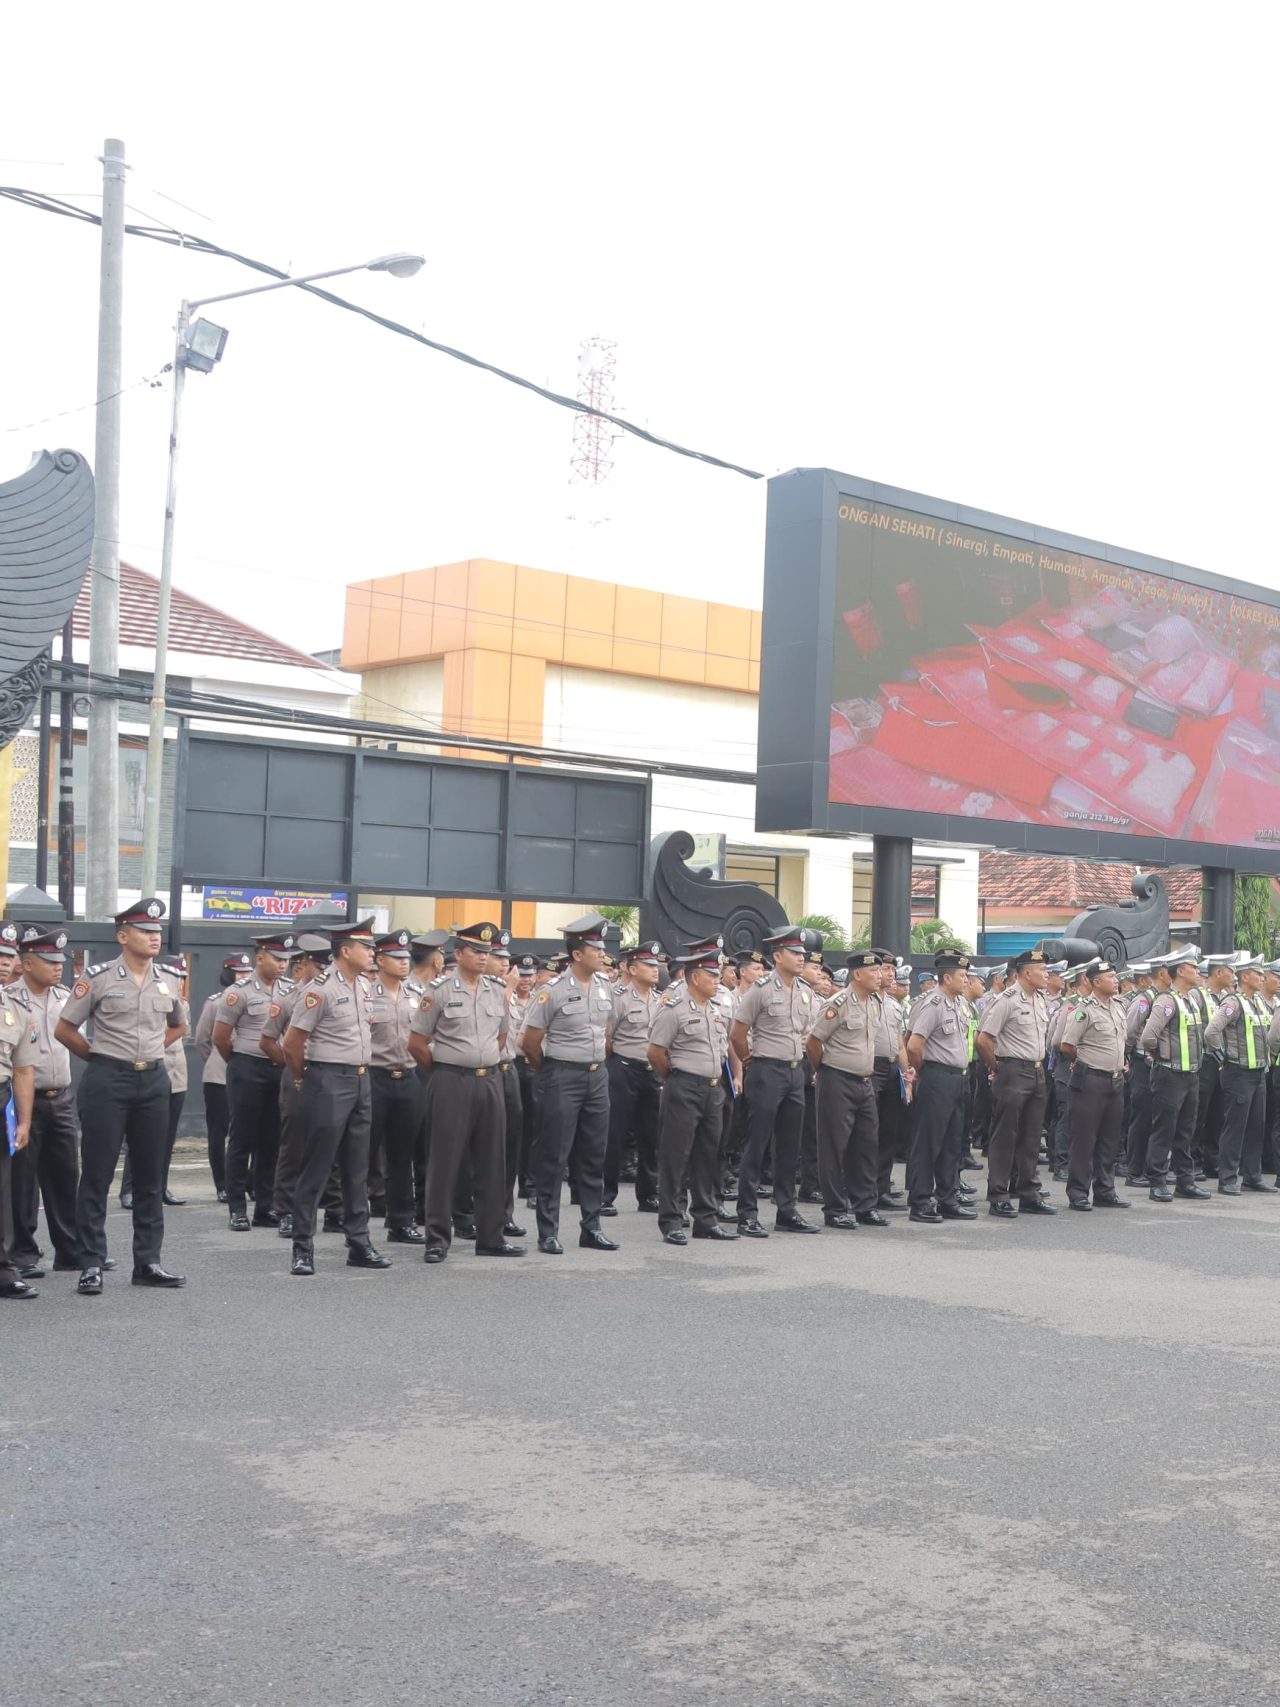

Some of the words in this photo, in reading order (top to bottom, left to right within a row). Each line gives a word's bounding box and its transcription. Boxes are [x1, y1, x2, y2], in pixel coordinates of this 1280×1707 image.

[838, 505, 889, 529] ONGAN
[891, 518, 936, 542] SEHATI
[945, 531, 988, 557] Sinergi,
[993, 544, 1035, 569] Empati,
[1039, 555, 1089, 582] Humanis,
[1092, 569, 1137, 593] Amanah,
[1230, 602, 1262, 623] POLRES
[1063, 810, 1088, 820] ganja
